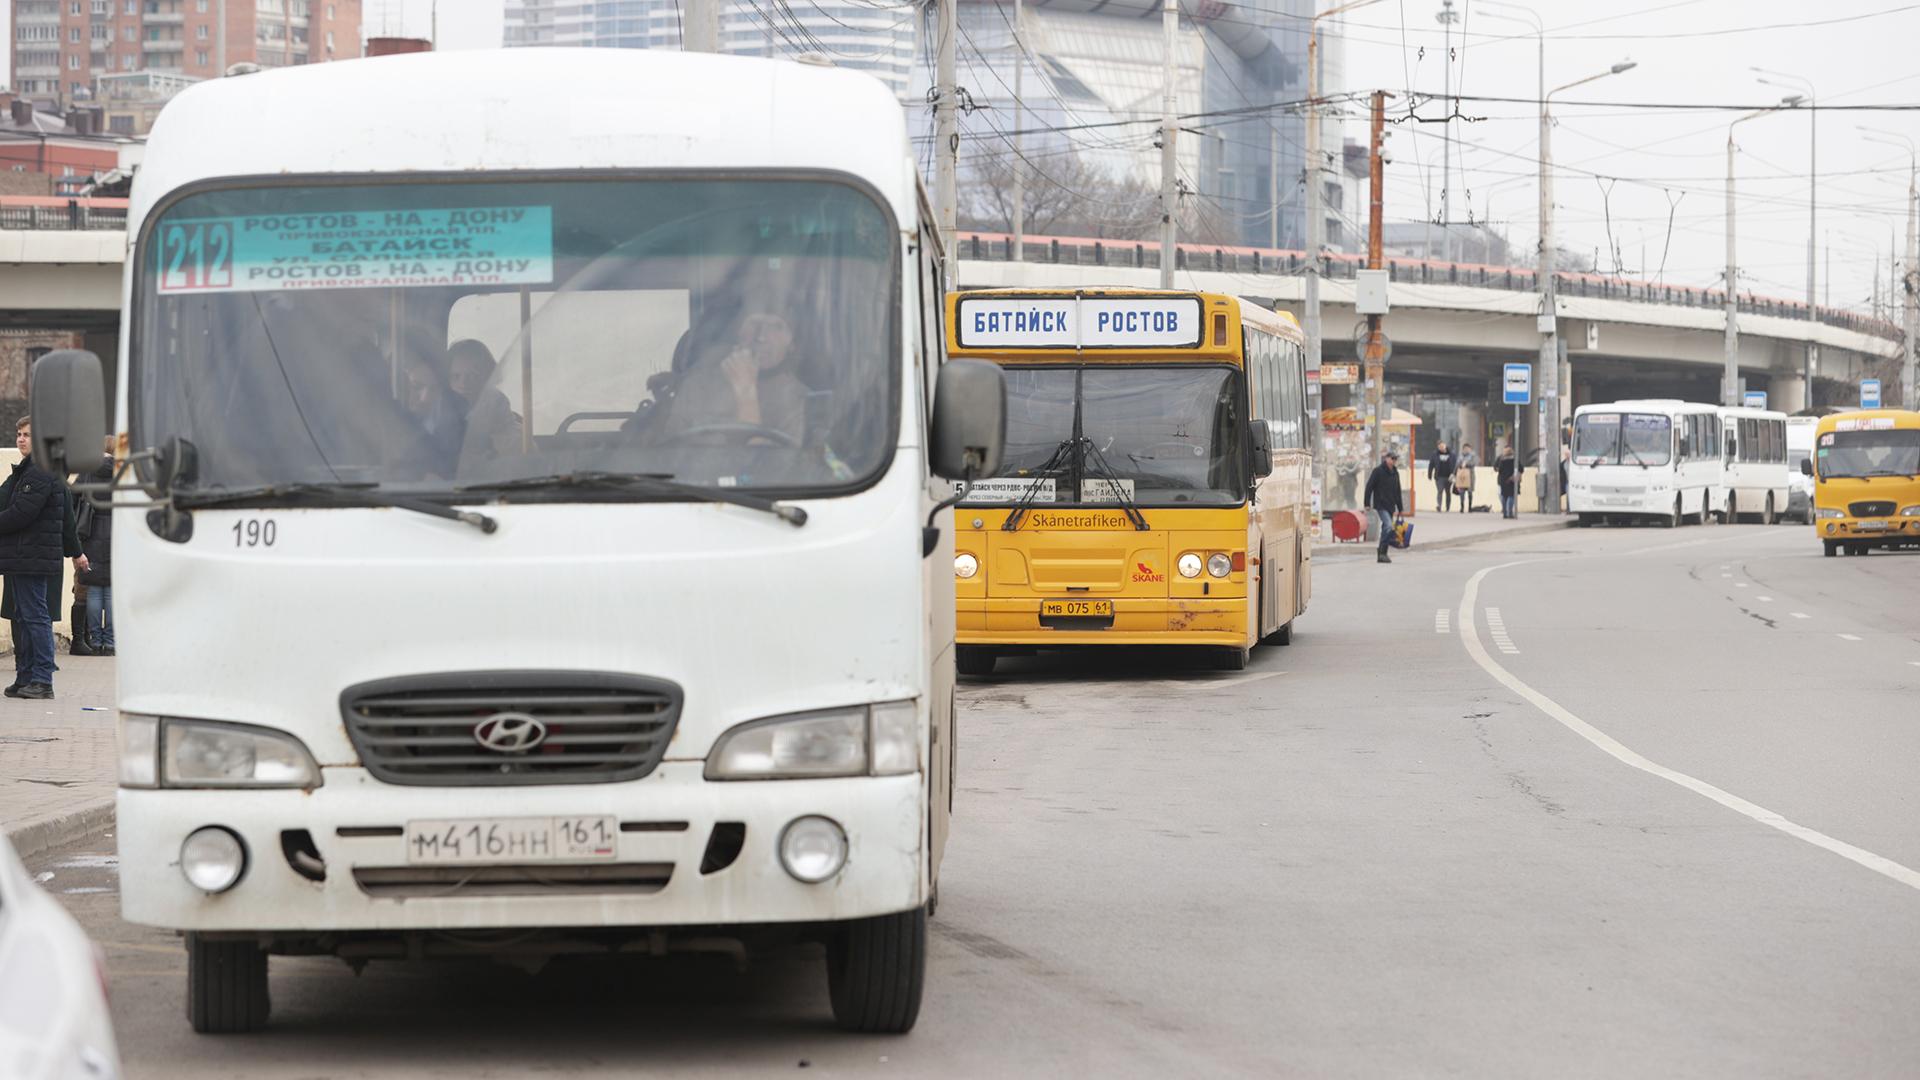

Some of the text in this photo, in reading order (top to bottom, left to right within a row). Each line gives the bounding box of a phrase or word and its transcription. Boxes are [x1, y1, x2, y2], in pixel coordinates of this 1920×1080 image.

[244, 215, 358, 231] РОСТОВ
[384, 212, 422, 227] НА
[448, 208, 526, 227] ДОНУ
[166, 223, 230, 287] 212
[249, 264, 362, 280] РОСТОВ
[390, 263, 427, 276] НА
[453, 259, 531, 276] ДОНУ
[974, 307, 1178, 333] БАТАЙСК РОСТОВ
[1032, 513, 1126, 527] Skånetrafiken
[232, 519, 276, 547] 190
[1067, 602, 1089, 614] 075
[1095, 602, 1107, 611] 61
[560, 819, 606, 844] 161
